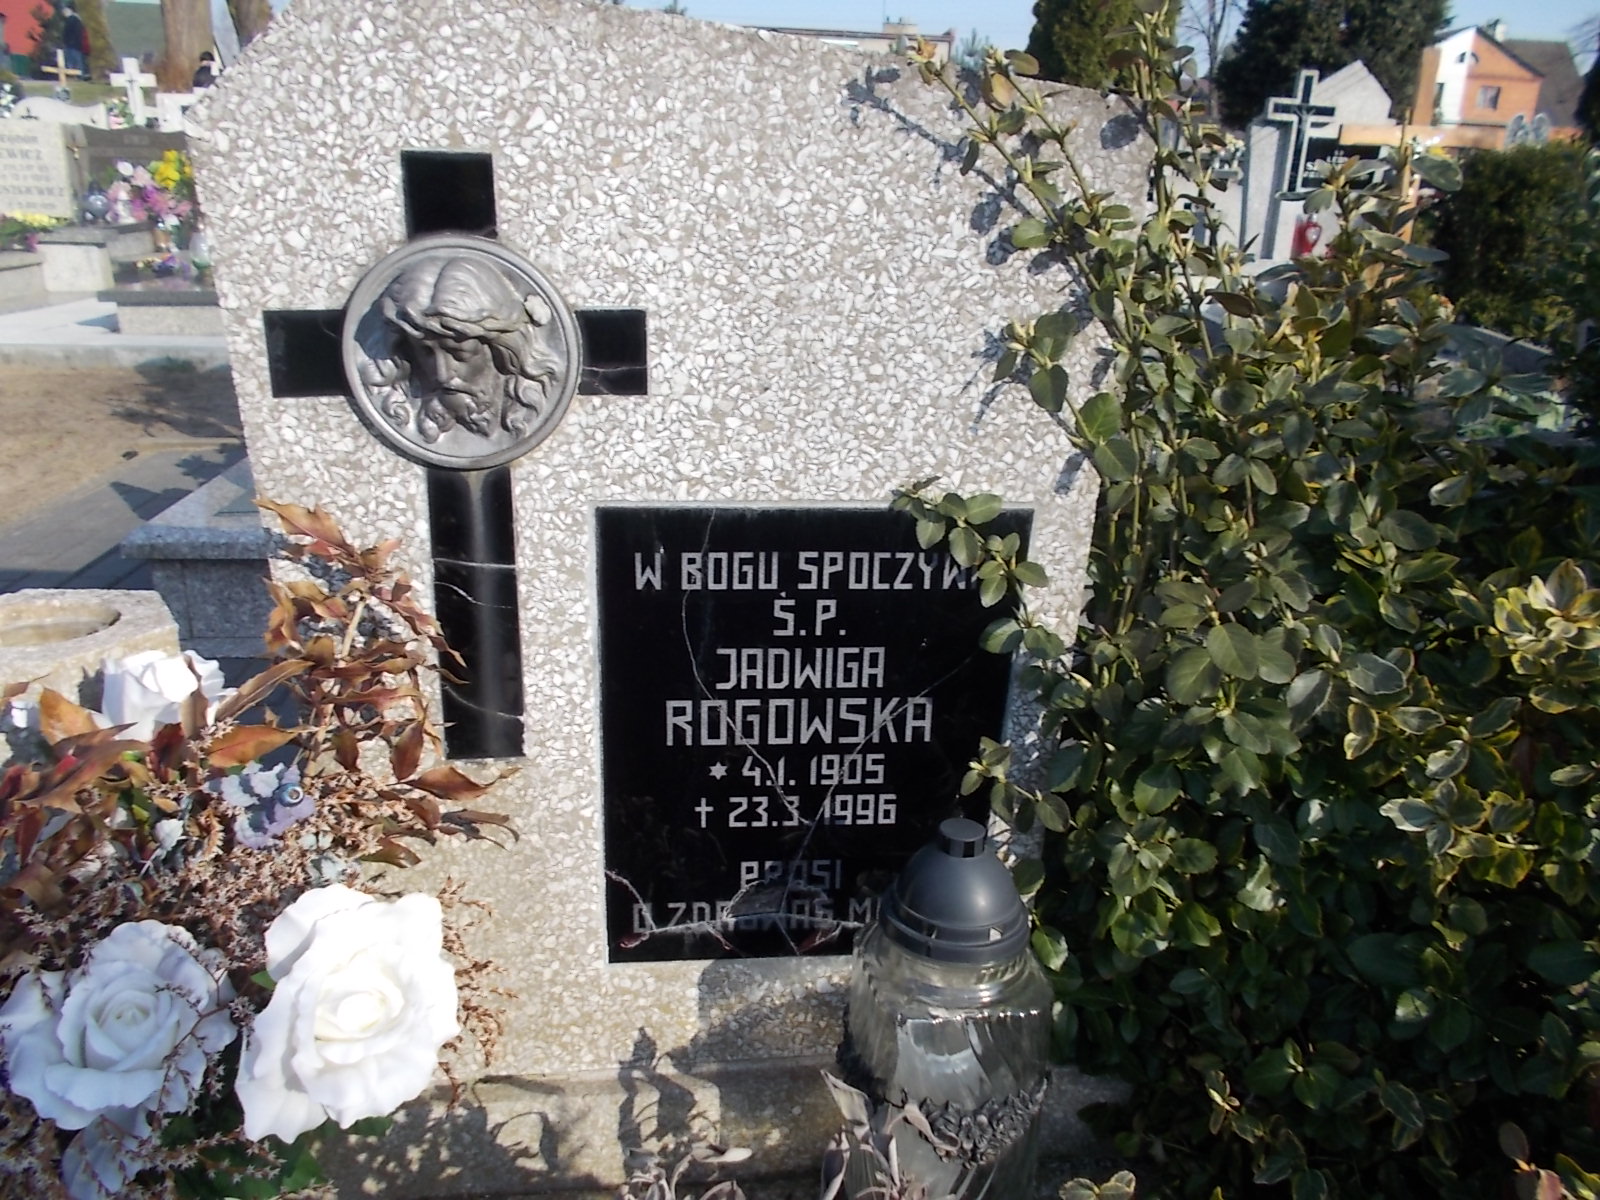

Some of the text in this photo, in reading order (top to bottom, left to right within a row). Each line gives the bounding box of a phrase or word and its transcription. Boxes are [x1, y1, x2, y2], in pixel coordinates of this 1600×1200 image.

[635, 550, 980, 591] W BOGU SPOCZYW
[715, 646, 886, 690] JADWIGA
[665, 697, 933, 746] ROGOWSKA
[810, 753, 885, 786] 1905
[823, 793, 897, 825] 1996
[740, 859, 842, 890] PROSI
